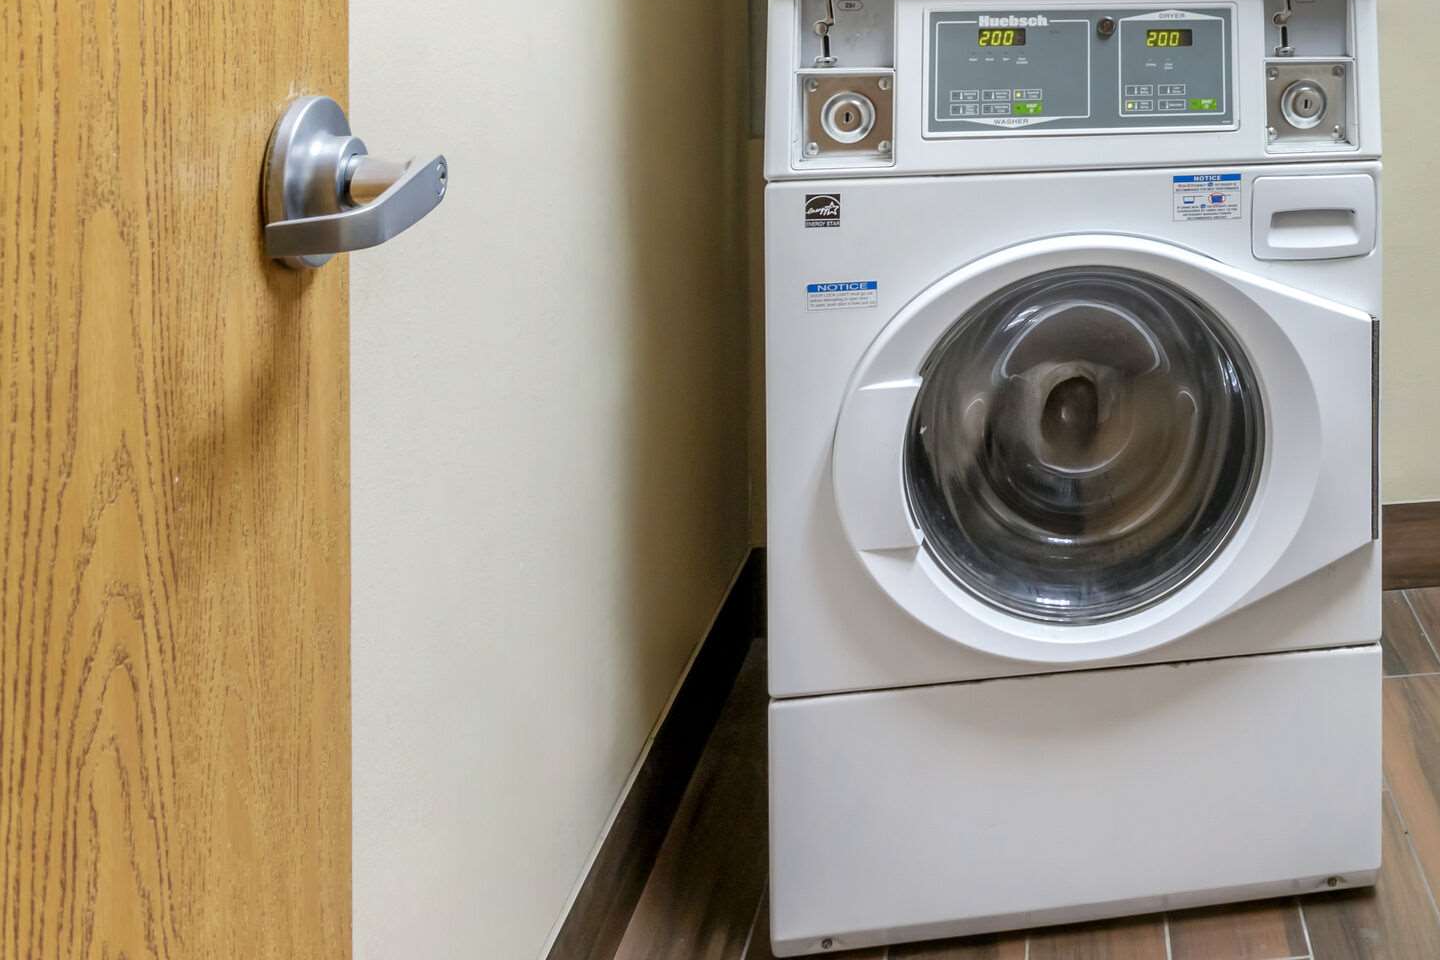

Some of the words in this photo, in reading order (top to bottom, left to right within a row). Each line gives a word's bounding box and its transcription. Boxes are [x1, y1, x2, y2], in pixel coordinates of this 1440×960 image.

[978, 15, 1048, 27] Huebsch
[979, 30, 1014, 46] 200
[1146, 31, 1180, 47] 200
[817, 283, 867, 292] NOTICE
